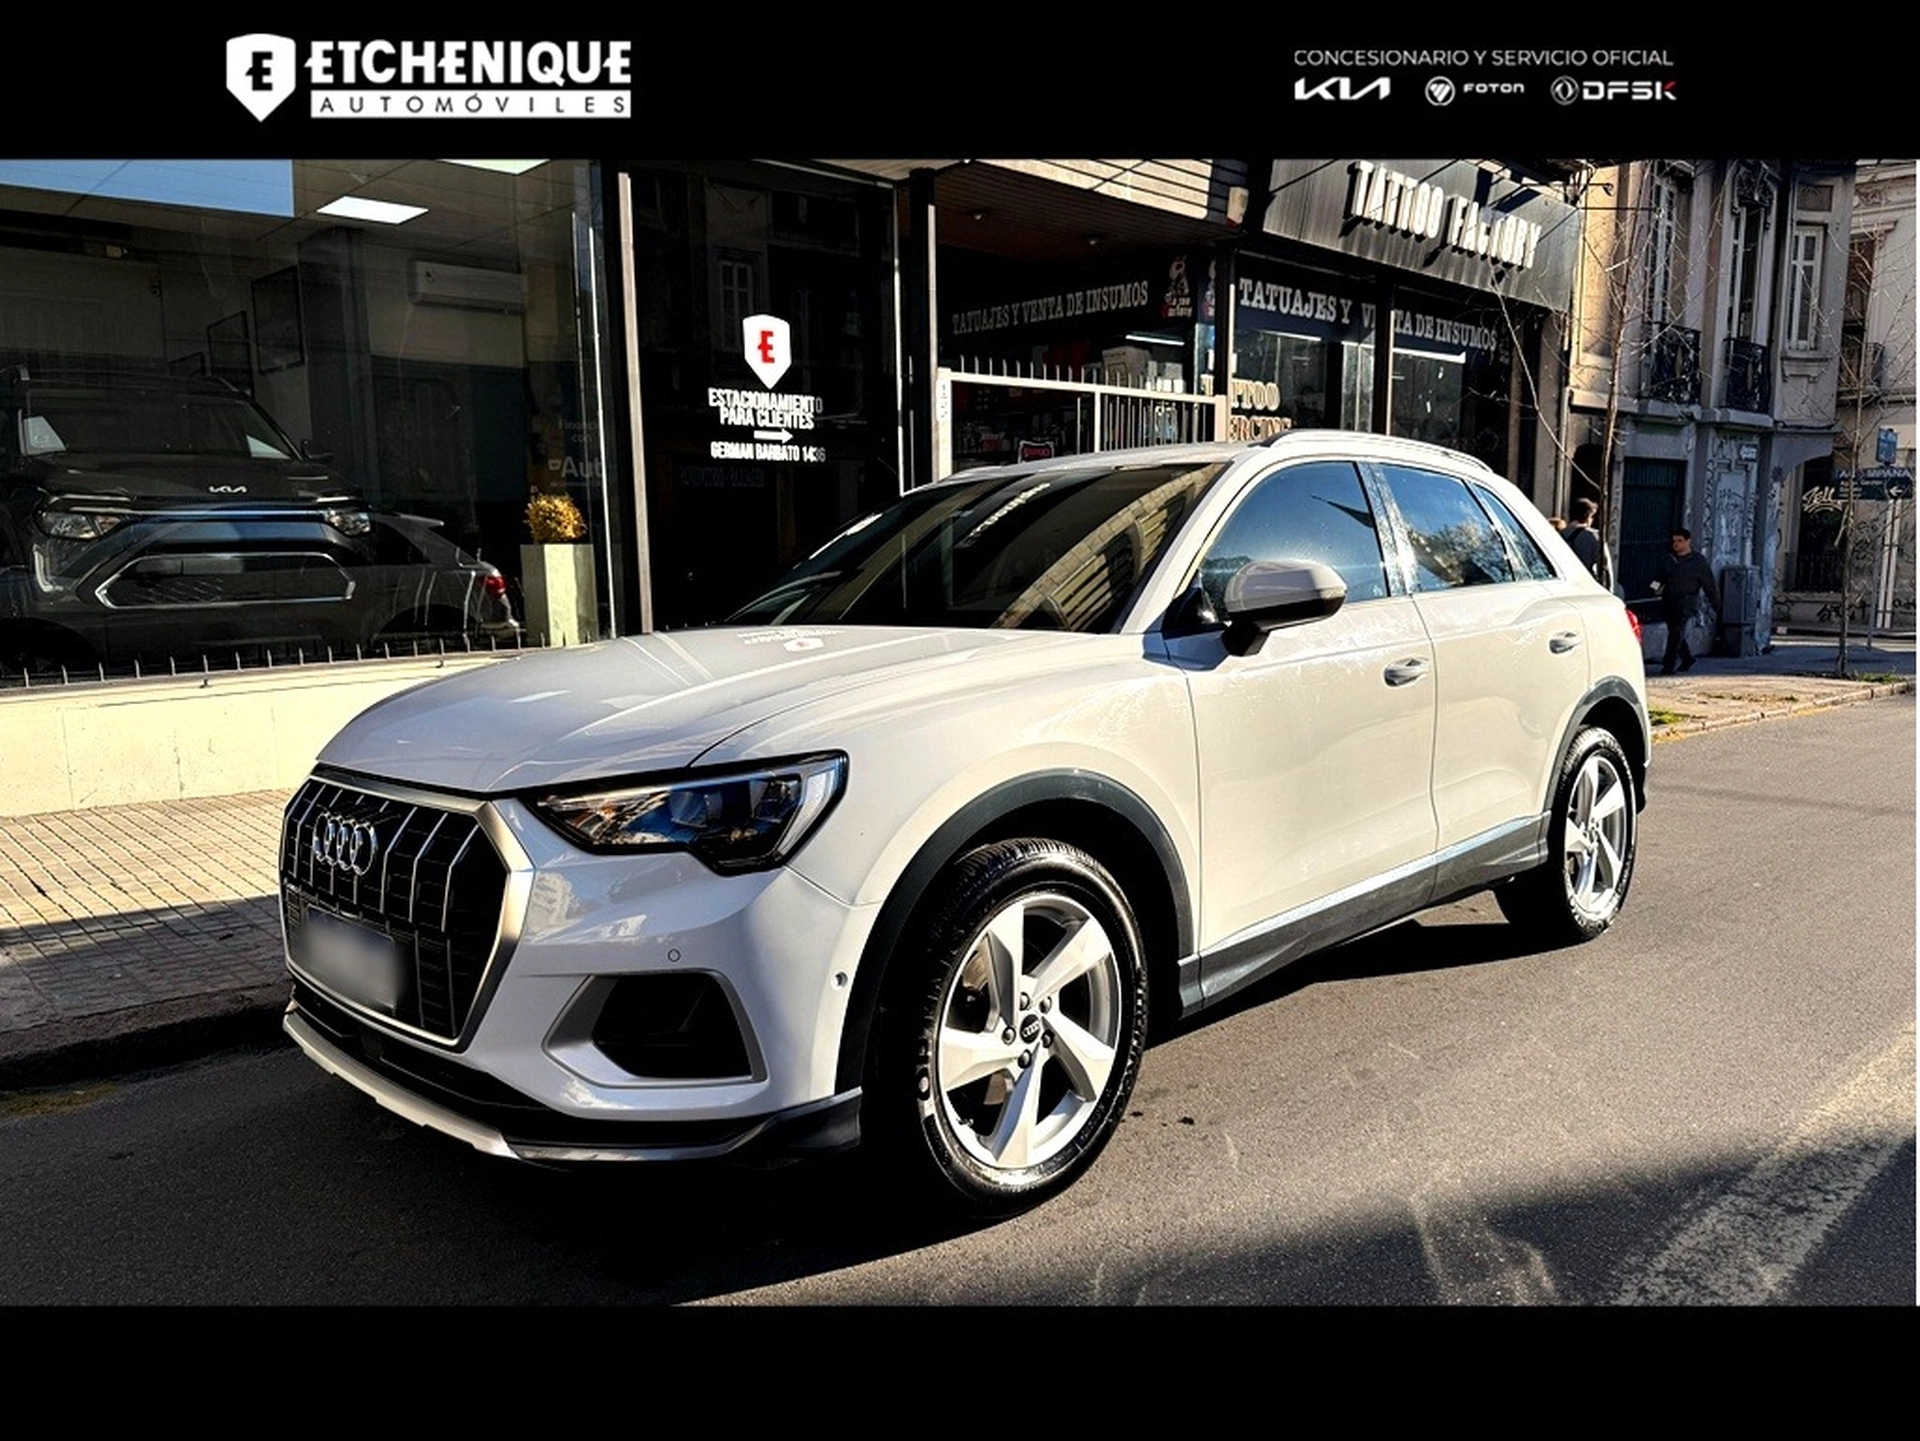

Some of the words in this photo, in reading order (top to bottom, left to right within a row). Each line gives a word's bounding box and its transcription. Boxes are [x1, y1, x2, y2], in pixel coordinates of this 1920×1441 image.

[1351, 160, 1444, 239] TATTOO
[1447, 194, 1542, 269] FACTORY
[952, 303, 1010, 335] TATUAJES
[1012, 302, 1021, 326] Y
[1023, 294, 1064, 324] VENTA
[1066, 291, 1084, 316] DE
[1085, 280, 1149, 315] INSUMOS
[1239, 276, 1337, 322] TATUAJES
[1340, 299, 1353, 325] Y
[1414, 312, 1435, 340] DE
[1435, 317, 1498, 351] INSUMOS
[708, 387, 824, 413] ESTACIONAMIENTO
[719, 406, 755, 427] PARA
[756, 409, 815, 430] CLIENTES
[710, 441, 755, 460] GERMAN
[755, 443, 800, 462] BARBATO
